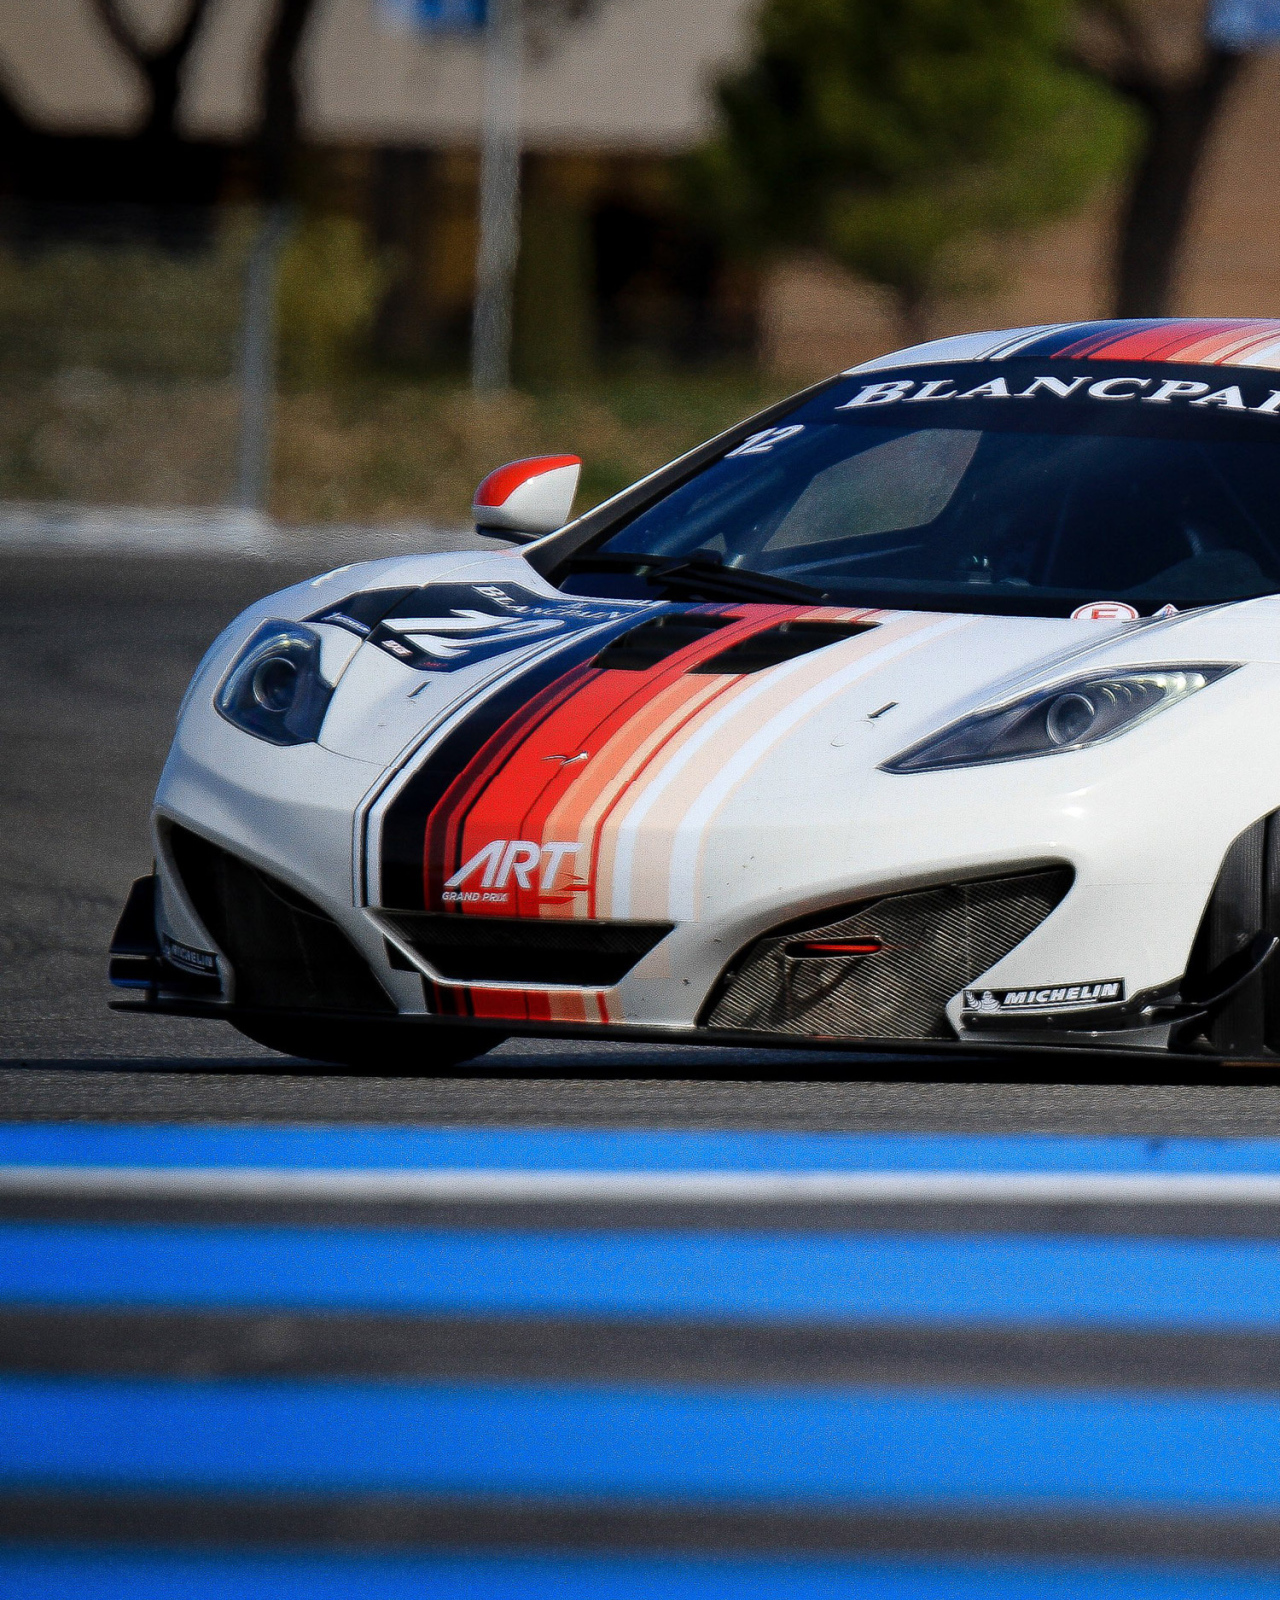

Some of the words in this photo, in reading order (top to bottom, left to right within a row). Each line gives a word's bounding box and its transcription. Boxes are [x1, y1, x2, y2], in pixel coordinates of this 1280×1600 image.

[724, 424, 805, 458] 12
[380, 608, 566, 659] 12
[443, 839, 585, 889] ART
[441, 890, 481, 902] GRAND
[481, 891, 509, 902] PRIX
[1004, 982, 1119, 1004] MICHELIN
